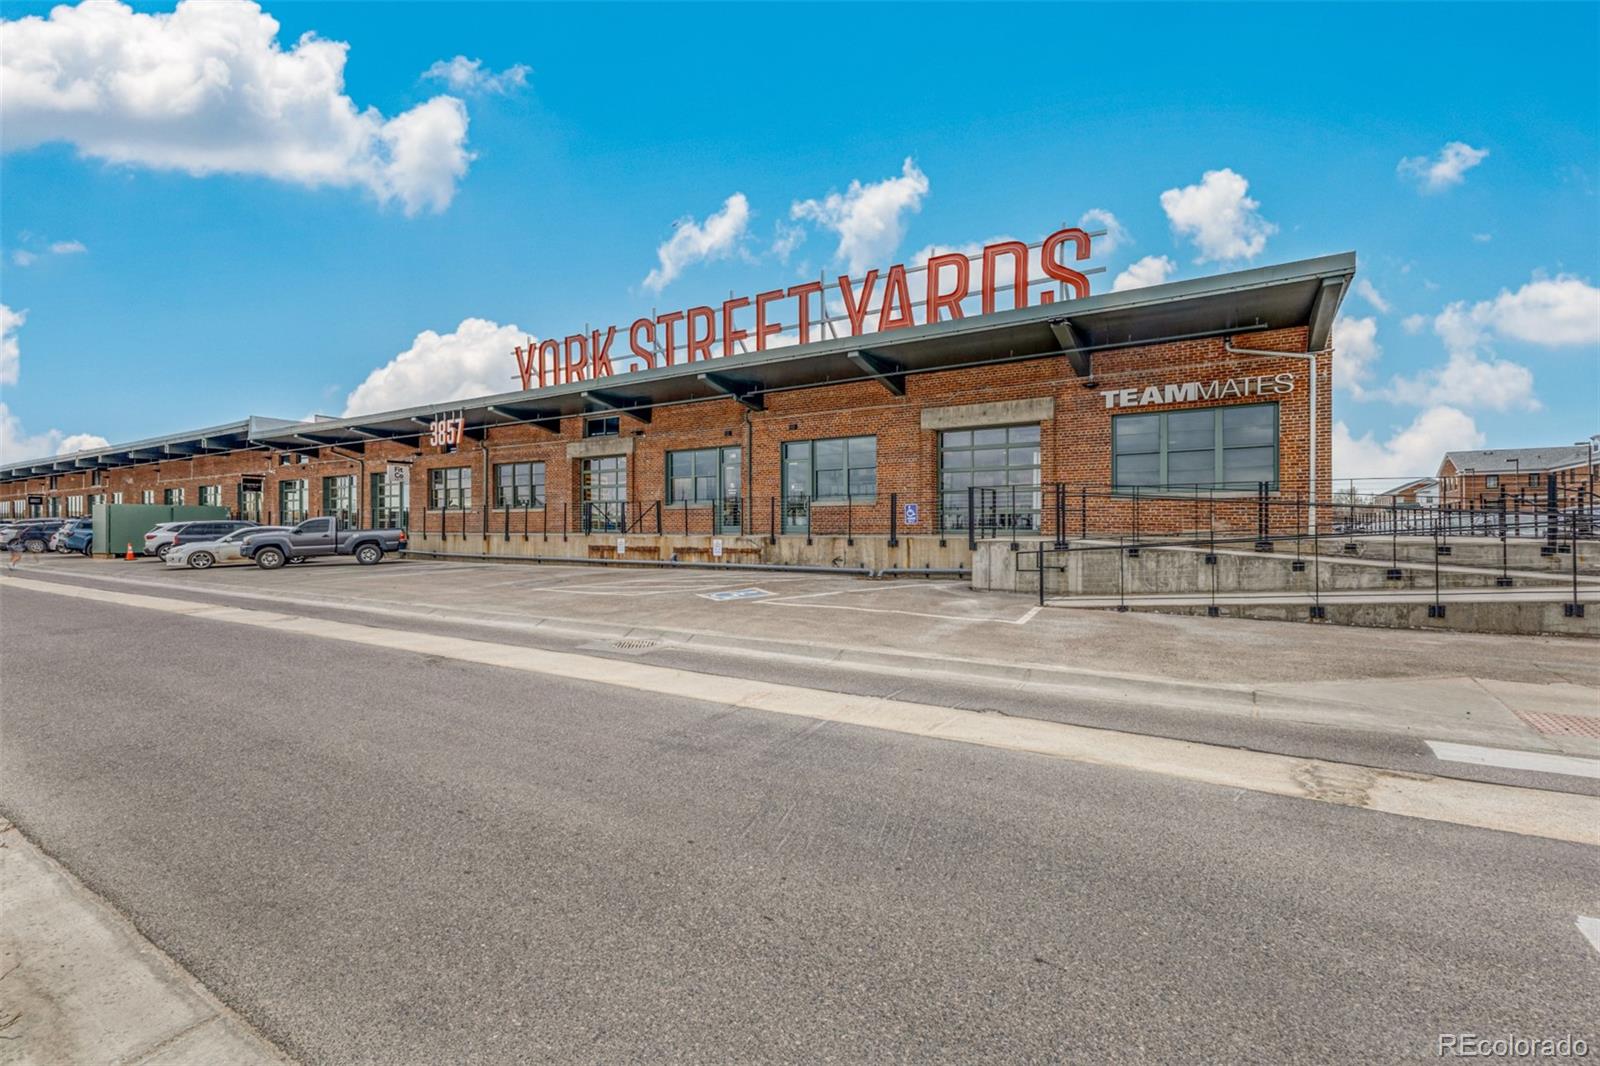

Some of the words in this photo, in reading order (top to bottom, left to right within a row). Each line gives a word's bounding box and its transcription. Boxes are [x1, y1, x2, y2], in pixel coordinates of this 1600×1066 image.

[514, 325, 617, 391] YORK
[629, 281, 822, 373] STREET
[838, 227, 1091, 337] YARDS
[1100, 372, 1295, 409] TEAMMATES
[430, 417, 465, 447] 3857
